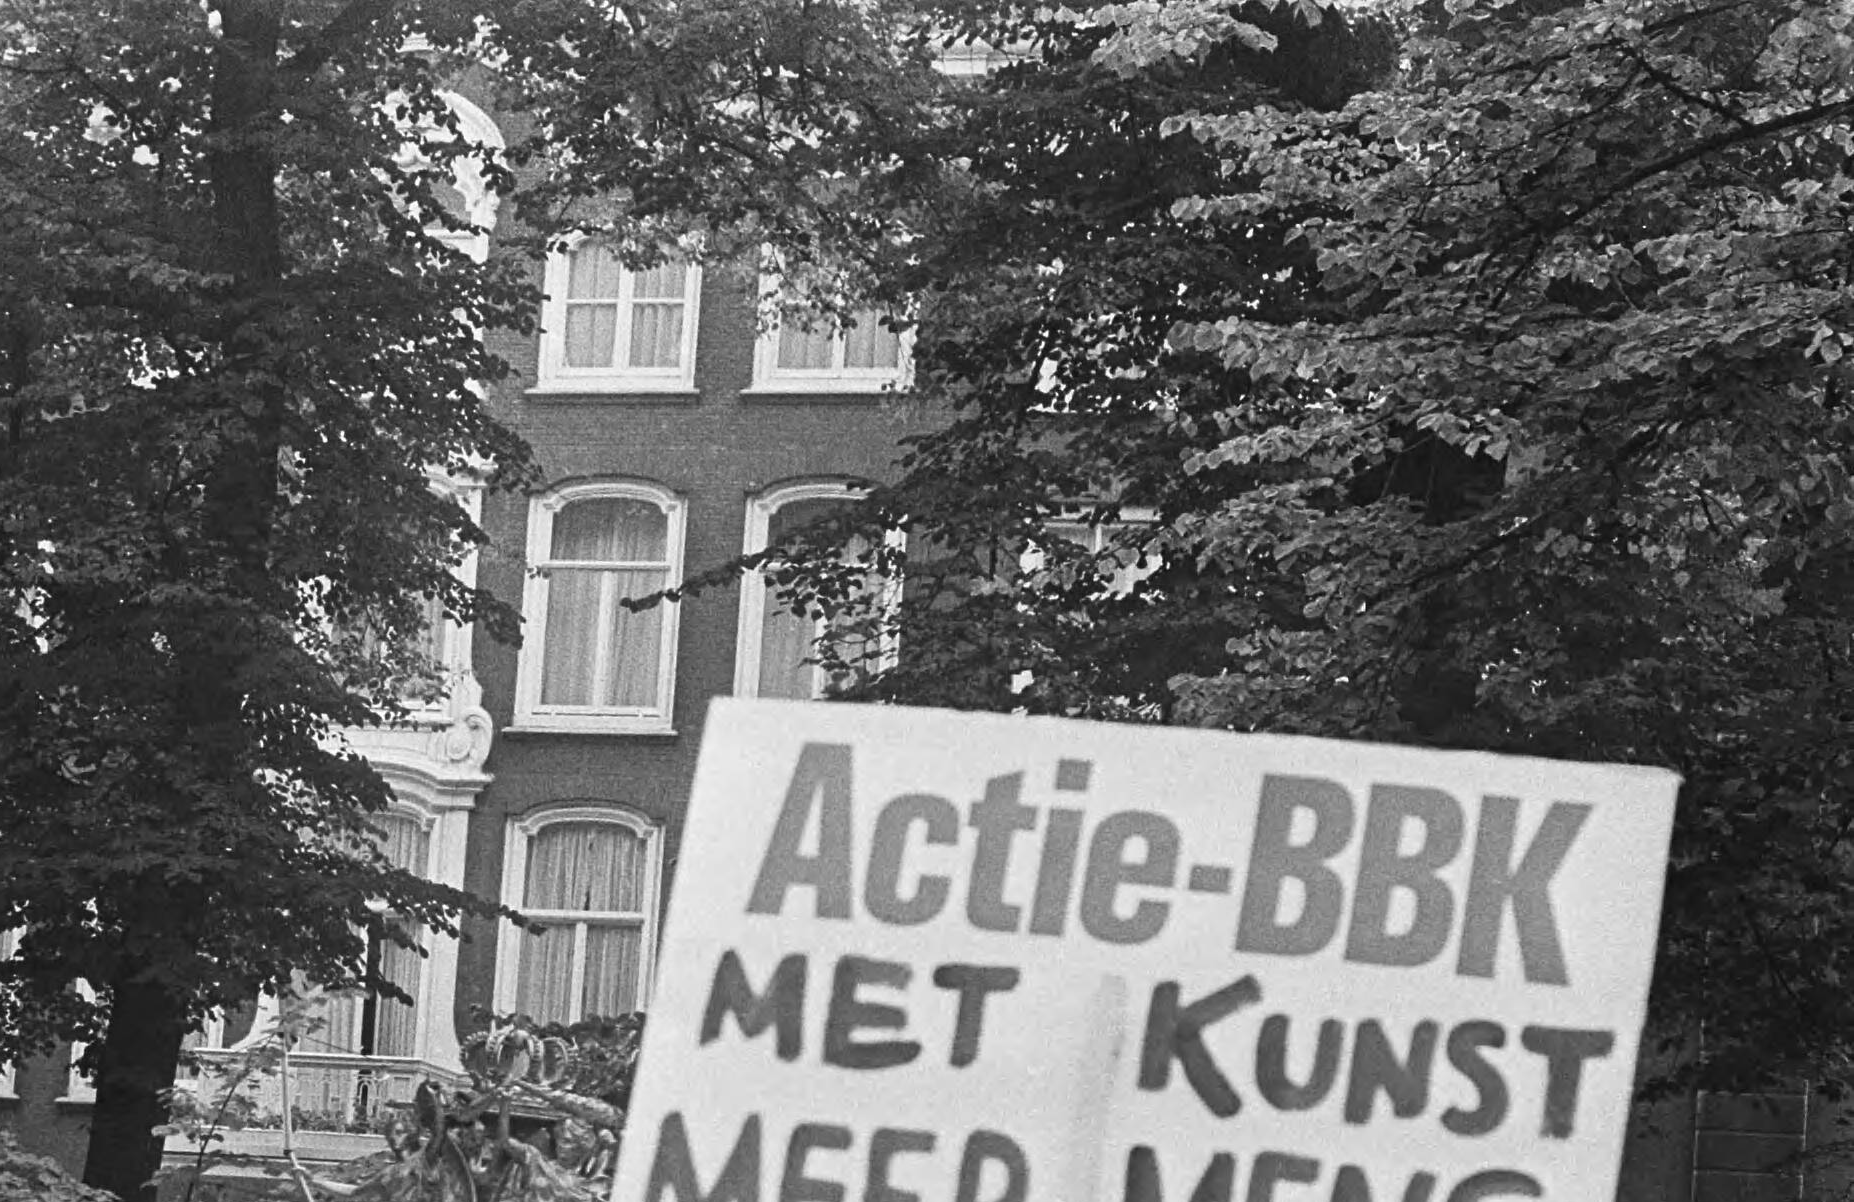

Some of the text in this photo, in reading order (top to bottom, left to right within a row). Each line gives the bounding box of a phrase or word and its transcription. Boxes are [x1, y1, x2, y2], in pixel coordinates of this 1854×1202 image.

[747, 742, 1593, 986] Actie-BBK
[699, 948, 1614, 1138] MET KUNST
